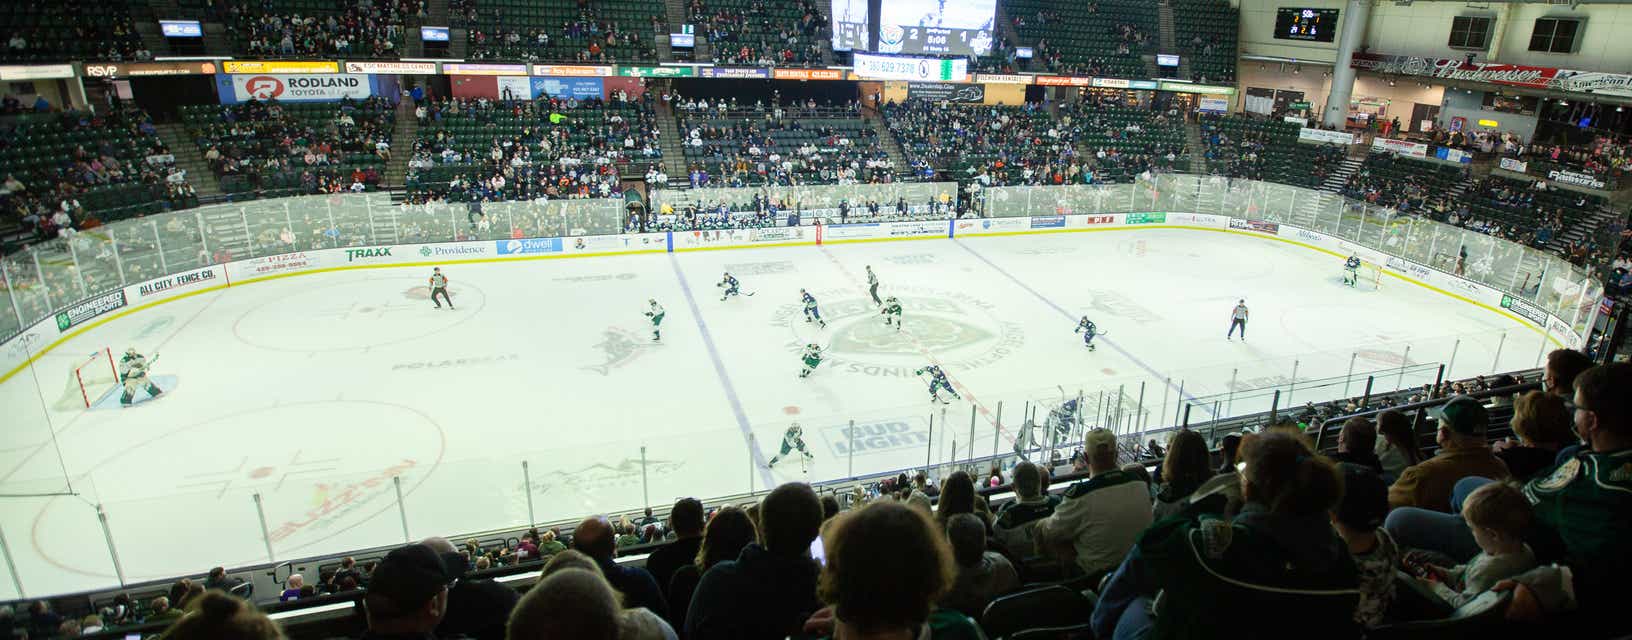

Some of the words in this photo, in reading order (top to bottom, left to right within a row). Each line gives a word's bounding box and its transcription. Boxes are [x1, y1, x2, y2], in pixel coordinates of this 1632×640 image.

[910, 29, 918, 39] 2
[960, 31, 967, 42] 1
[87, 66, 118, 77] RSVP
[1434, 57, 1543, 81] Budweiser
[288, 77, 359, 88] RODLAND
[523, 238, 553, 249] dwell
[267, 251, 307, 263] PIZZA
[345, 246, 392, 262] TRAXX
[434, 245, 486, 256] Providence
[139, 284, 154, 297] ALL
[153, 277, 173, 293] CITY
[177, 272, 201, 286] FENCE
[201, 269, 217, 281] CO.
[67, 292, 122, 318] ENGINEERED
[94, 300, 123, 315] SPORTS
[841, 422, 909, 440] BUD
[834, 431, 930, 454] LIGHT
